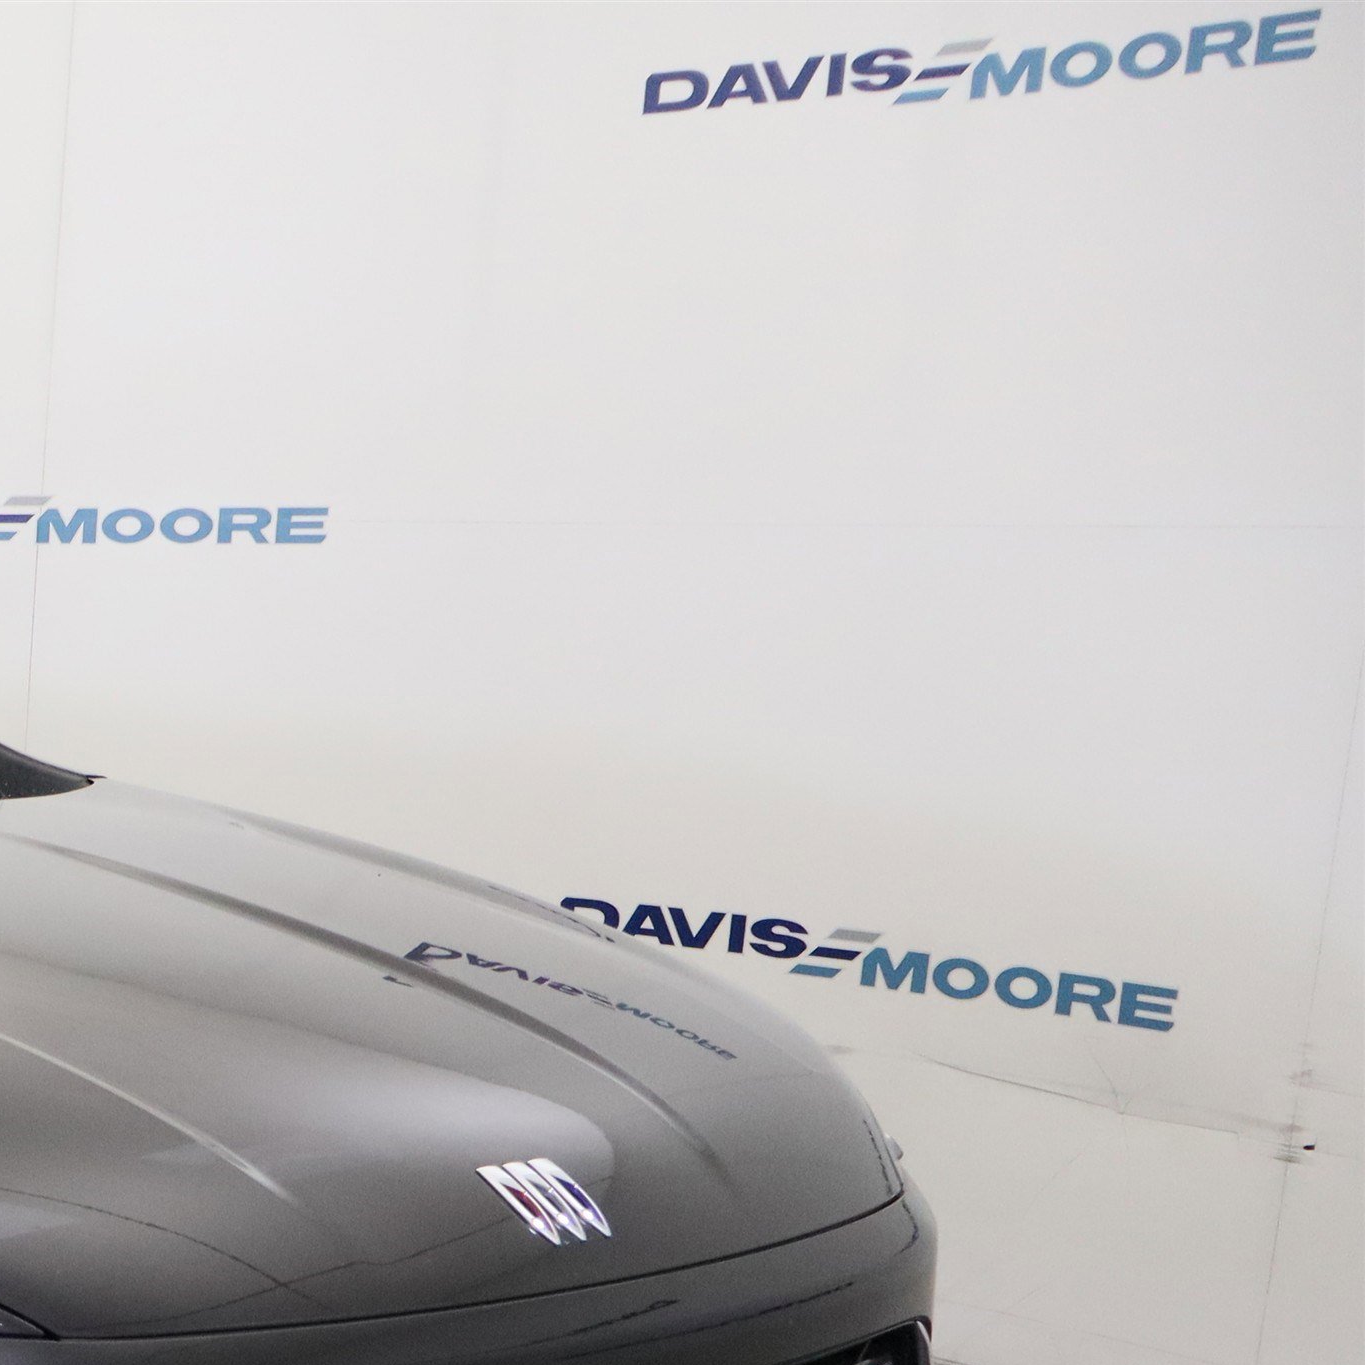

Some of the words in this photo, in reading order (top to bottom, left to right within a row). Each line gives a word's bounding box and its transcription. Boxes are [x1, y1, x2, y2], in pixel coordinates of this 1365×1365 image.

[642, 47, 912, 114] DAVIS
[969, 9, 1323, 101] MOORE
[35, 505, 330, 545] MOORE
[859, 946, 1180, 1033] MOORE
